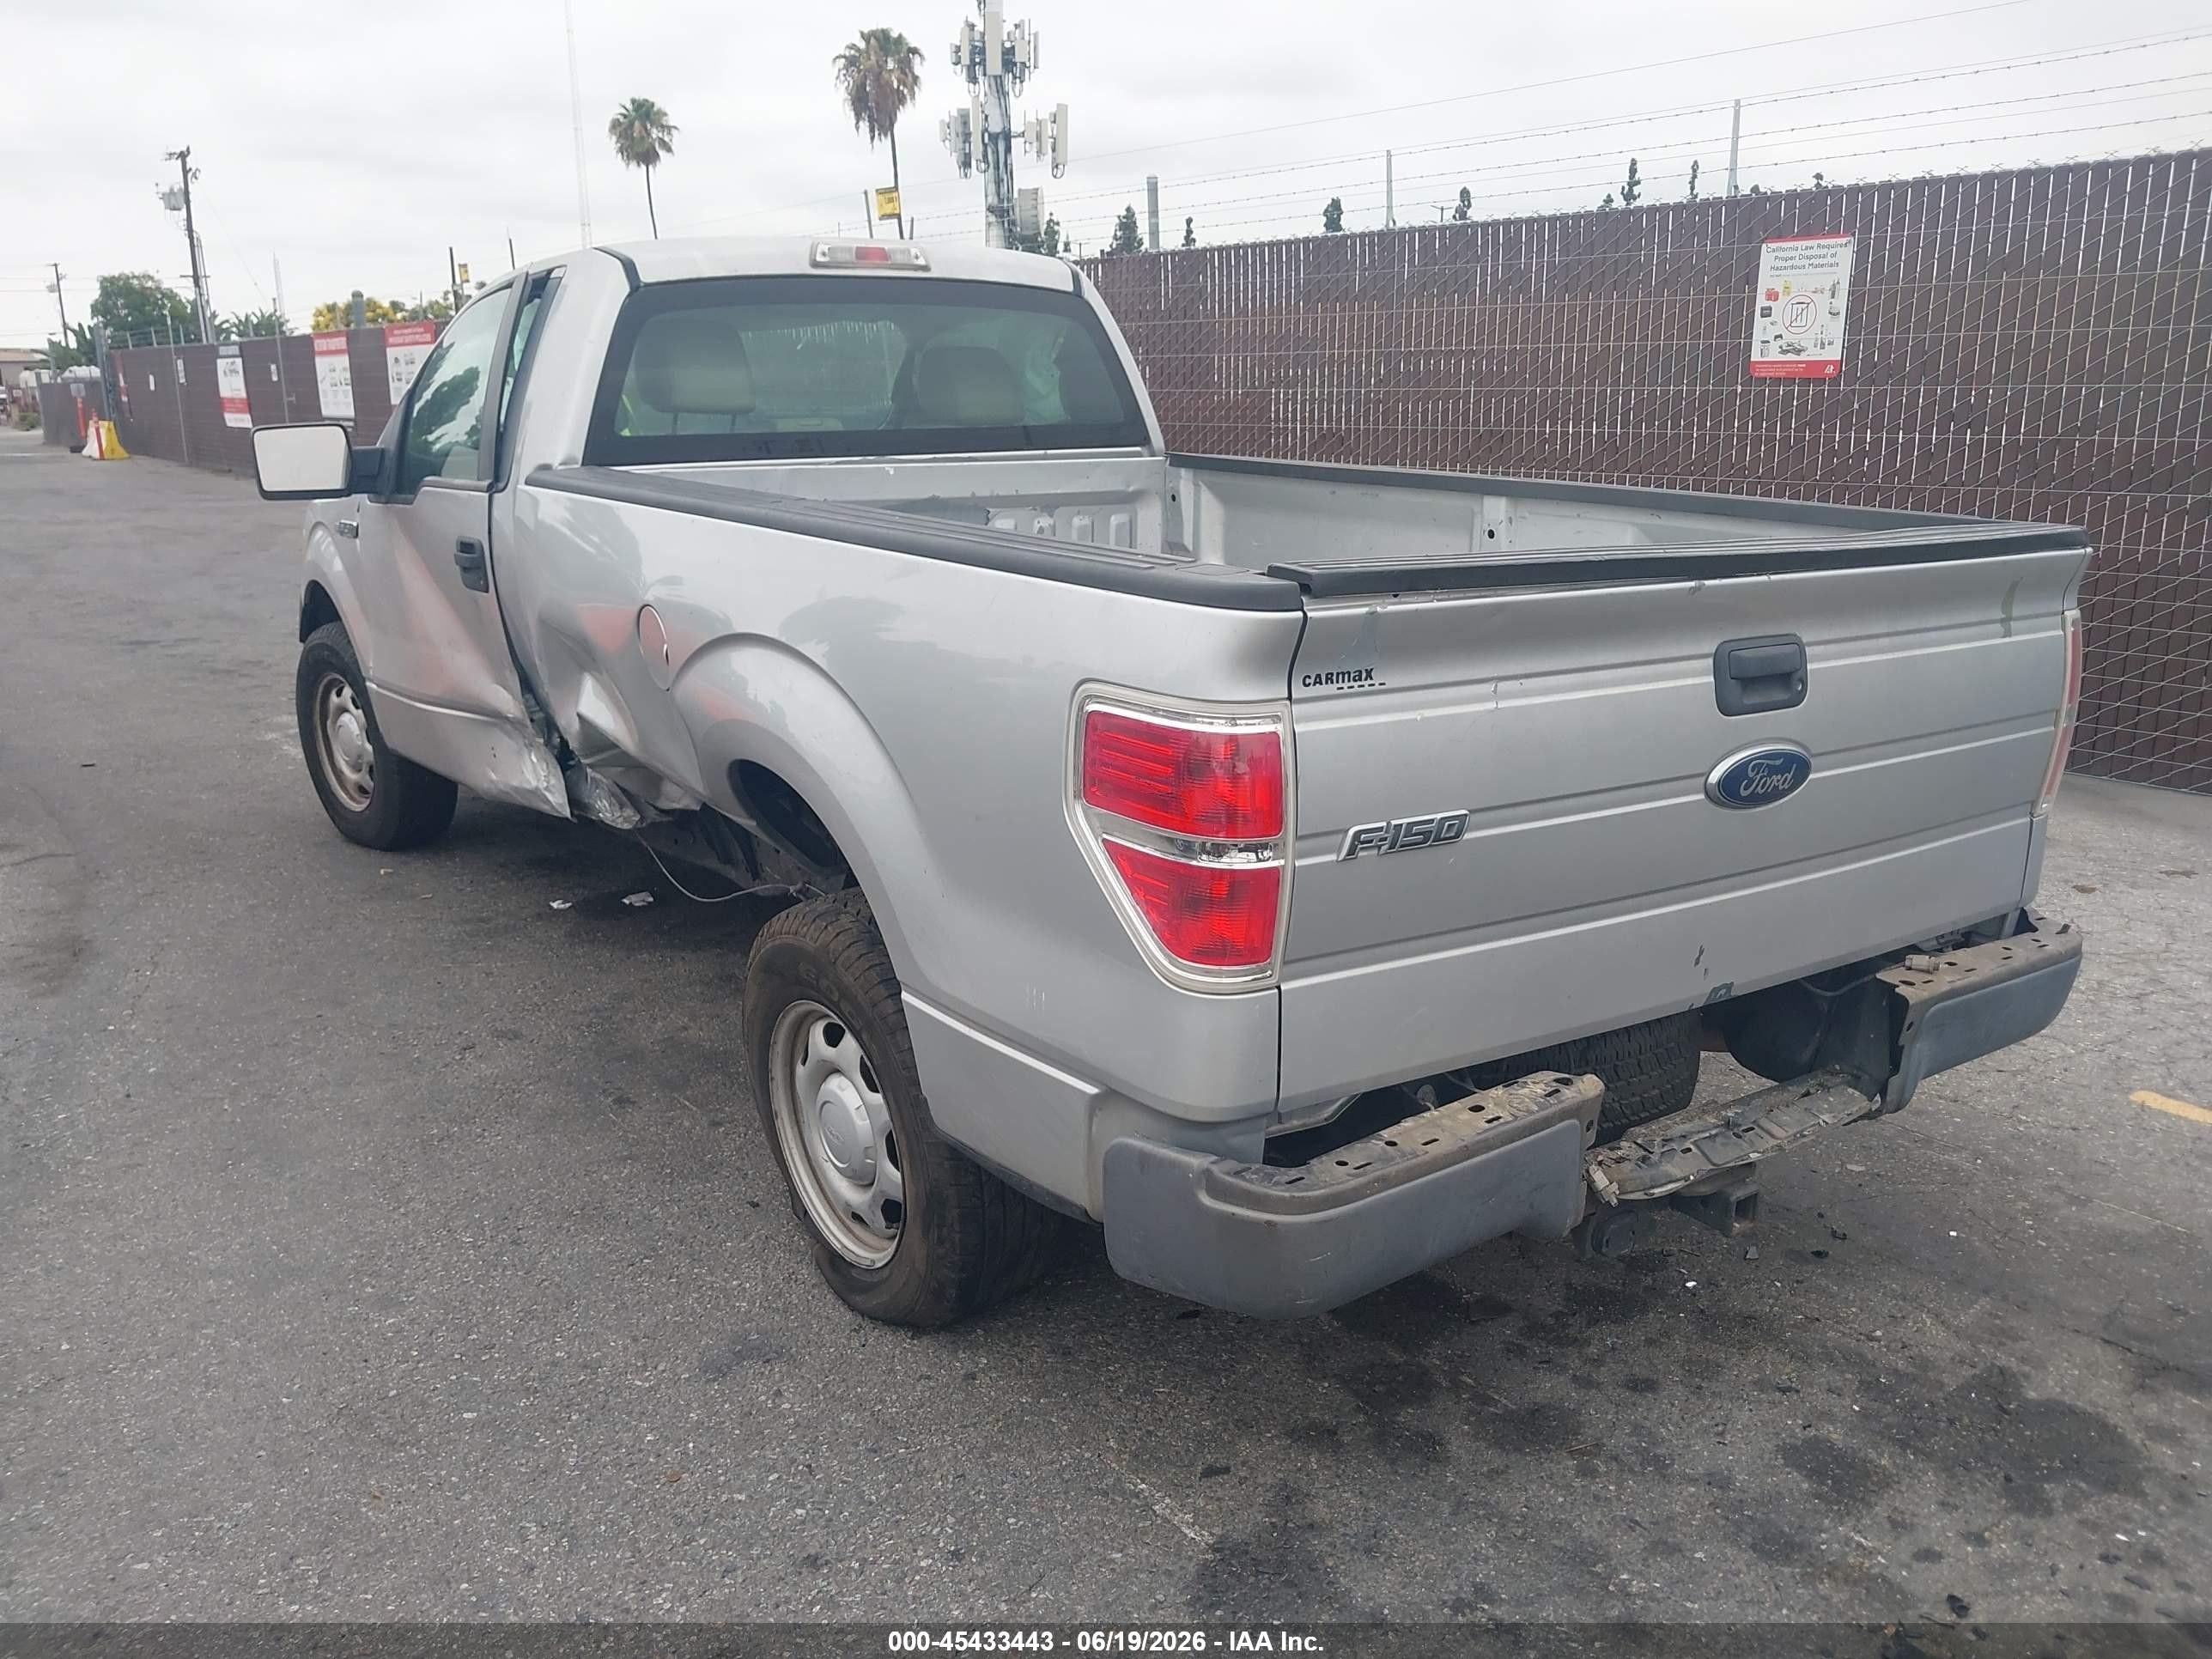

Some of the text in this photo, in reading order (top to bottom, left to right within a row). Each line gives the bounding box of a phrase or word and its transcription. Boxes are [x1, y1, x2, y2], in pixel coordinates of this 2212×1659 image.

[1765, 245, 1799, 253] California
[1816, 241, 1849, 251] Requires
[1798, 252, 1828, 261] Disposal
[1740, 757, 1797, 797] Ford
[1337, 809, 1470, 862] F-150
